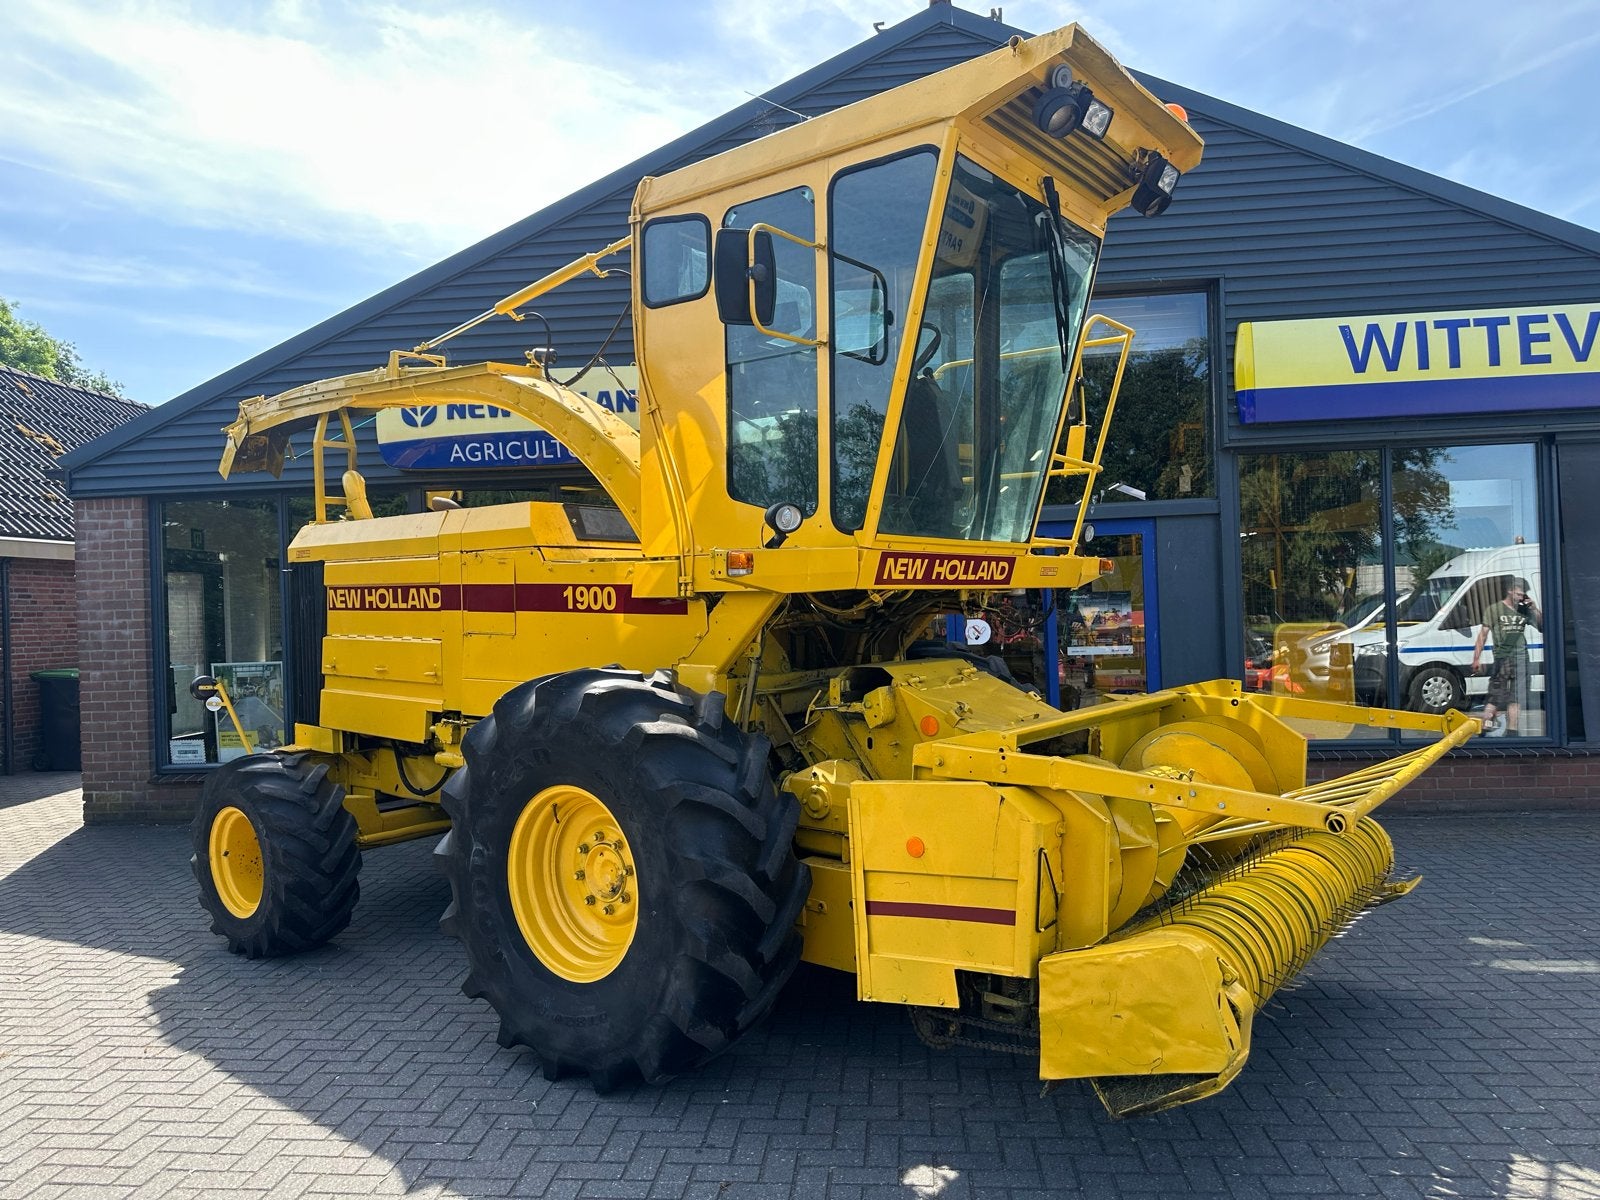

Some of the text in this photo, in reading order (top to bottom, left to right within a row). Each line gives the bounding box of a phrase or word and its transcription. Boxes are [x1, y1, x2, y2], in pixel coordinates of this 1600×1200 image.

[1339, 311, 1600, 374] WITTEV
[883, 557, 1009, 580] NEW HOLLAND
[329, 588, 441, 609] NEW HOLLAND
[563, 585, 617, 610] 1900
